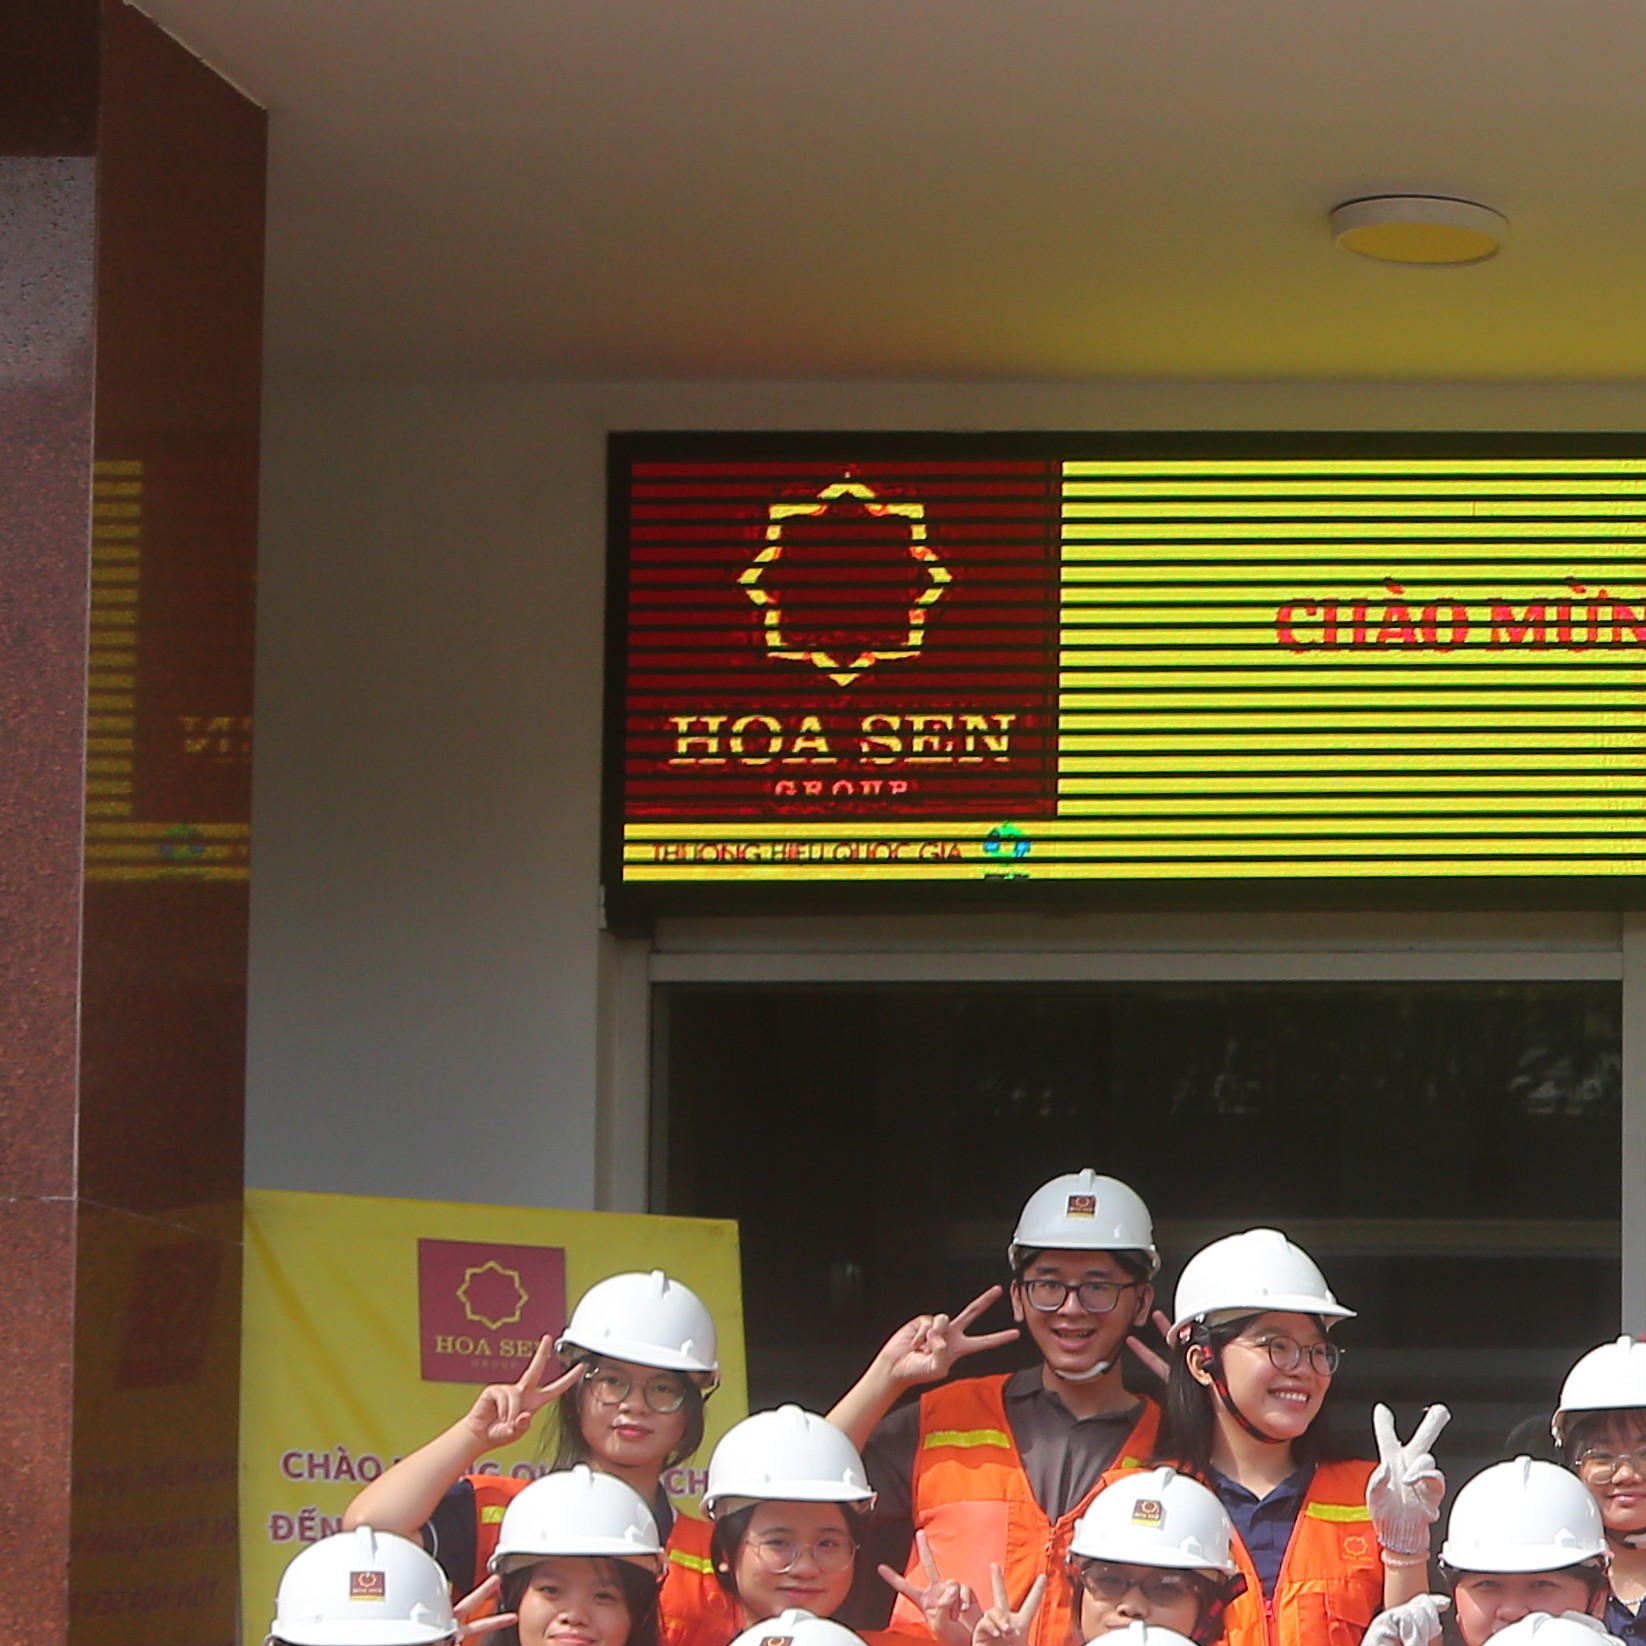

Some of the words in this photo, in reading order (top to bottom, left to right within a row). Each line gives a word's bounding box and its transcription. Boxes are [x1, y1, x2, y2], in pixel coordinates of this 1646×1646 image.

[1275, 577, 1471, 653] CHÀO
[669, 714, 838, 765] HOA
[859, 714, 1016, 765] SEN
[435, 1334, 492, 1356] HOA
[499, 1338, 541, 1358] SE
[281, 1445, 383, 1483] CHÀO
